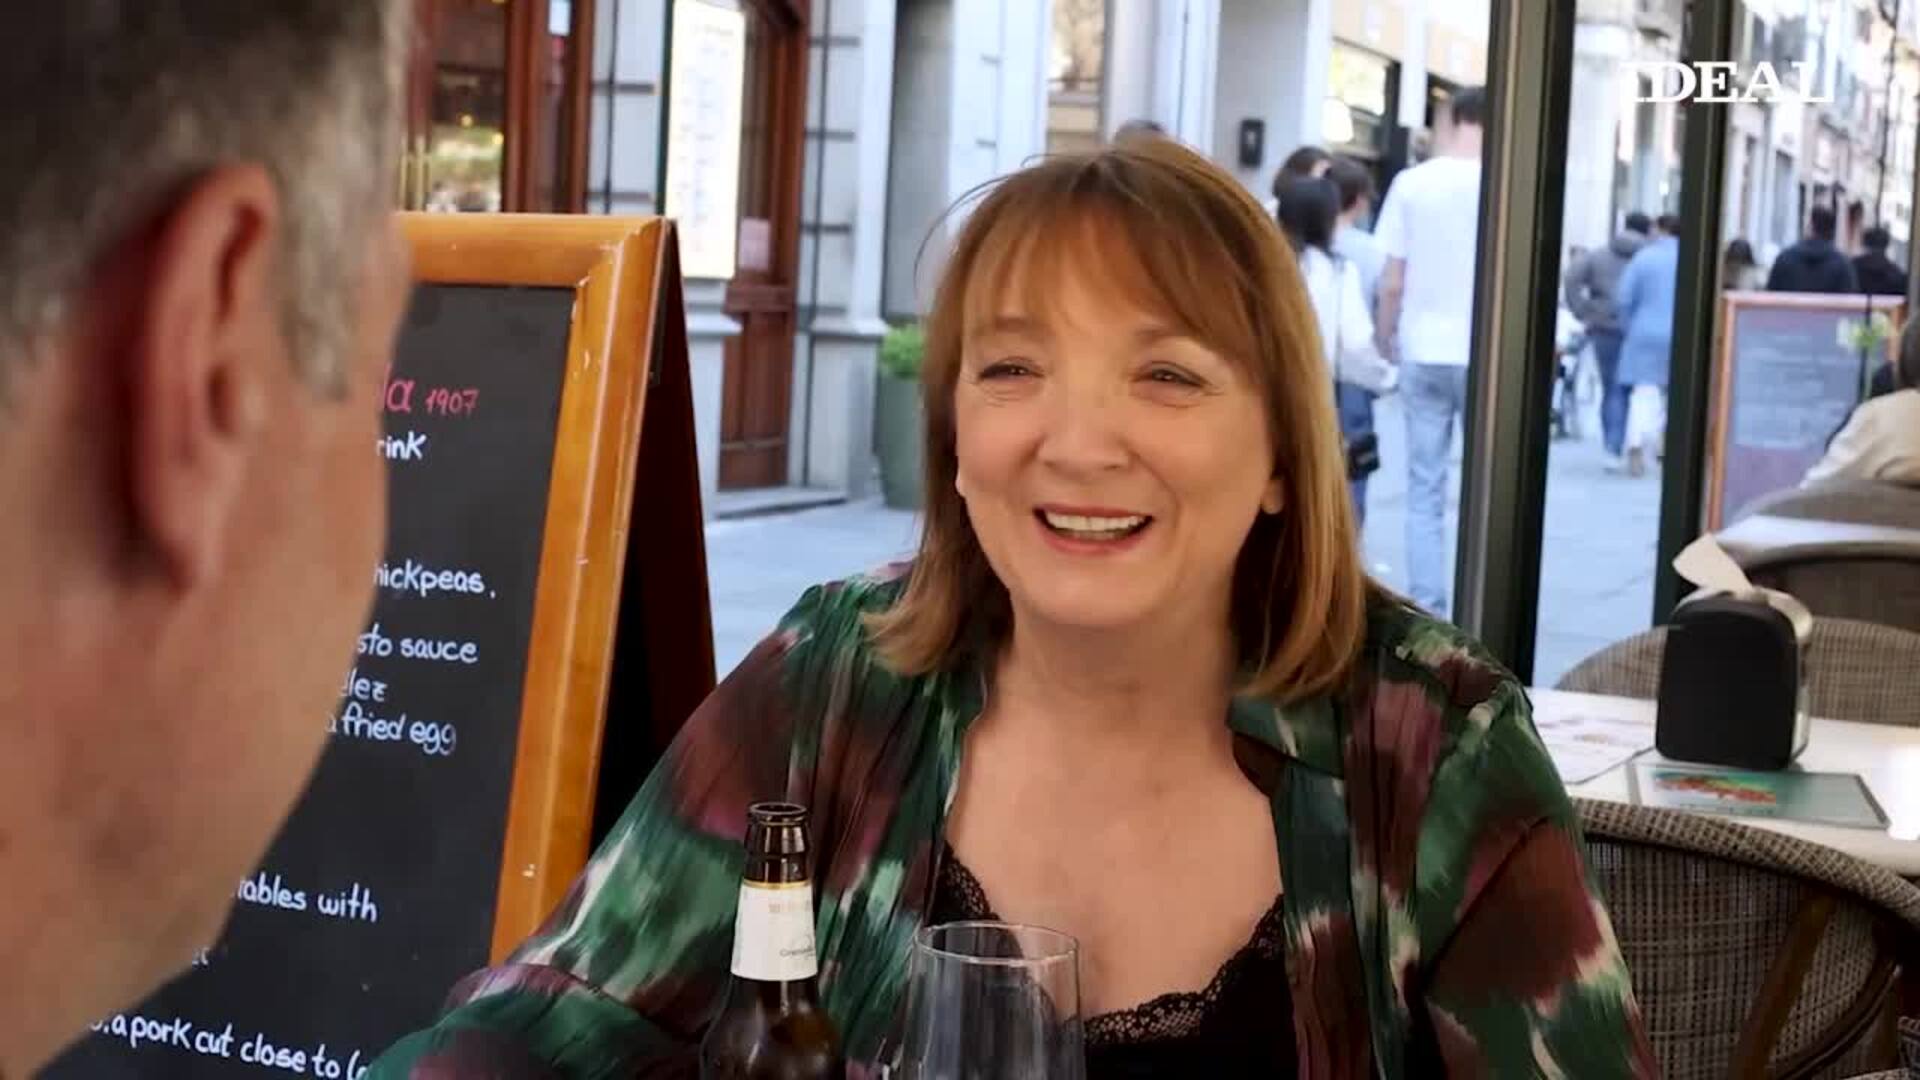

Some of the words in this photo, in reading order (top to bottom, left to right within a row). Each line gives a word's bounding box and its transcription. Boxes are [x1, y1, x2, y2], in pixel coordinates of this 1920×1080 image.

[425, 387, 480, 415] 1907
[400, 638, 478, 663] sauce
[341, 702, 407, 740] fried
[410, 721, 457, 756] egg
[317, 883, 378, 923] with
[130, 1017, 193, 1049] pork
[194, 1023, 234, 1057] cut
[240, 1033, 307, 1072] close
[312, 1043, 341, 1079] to
